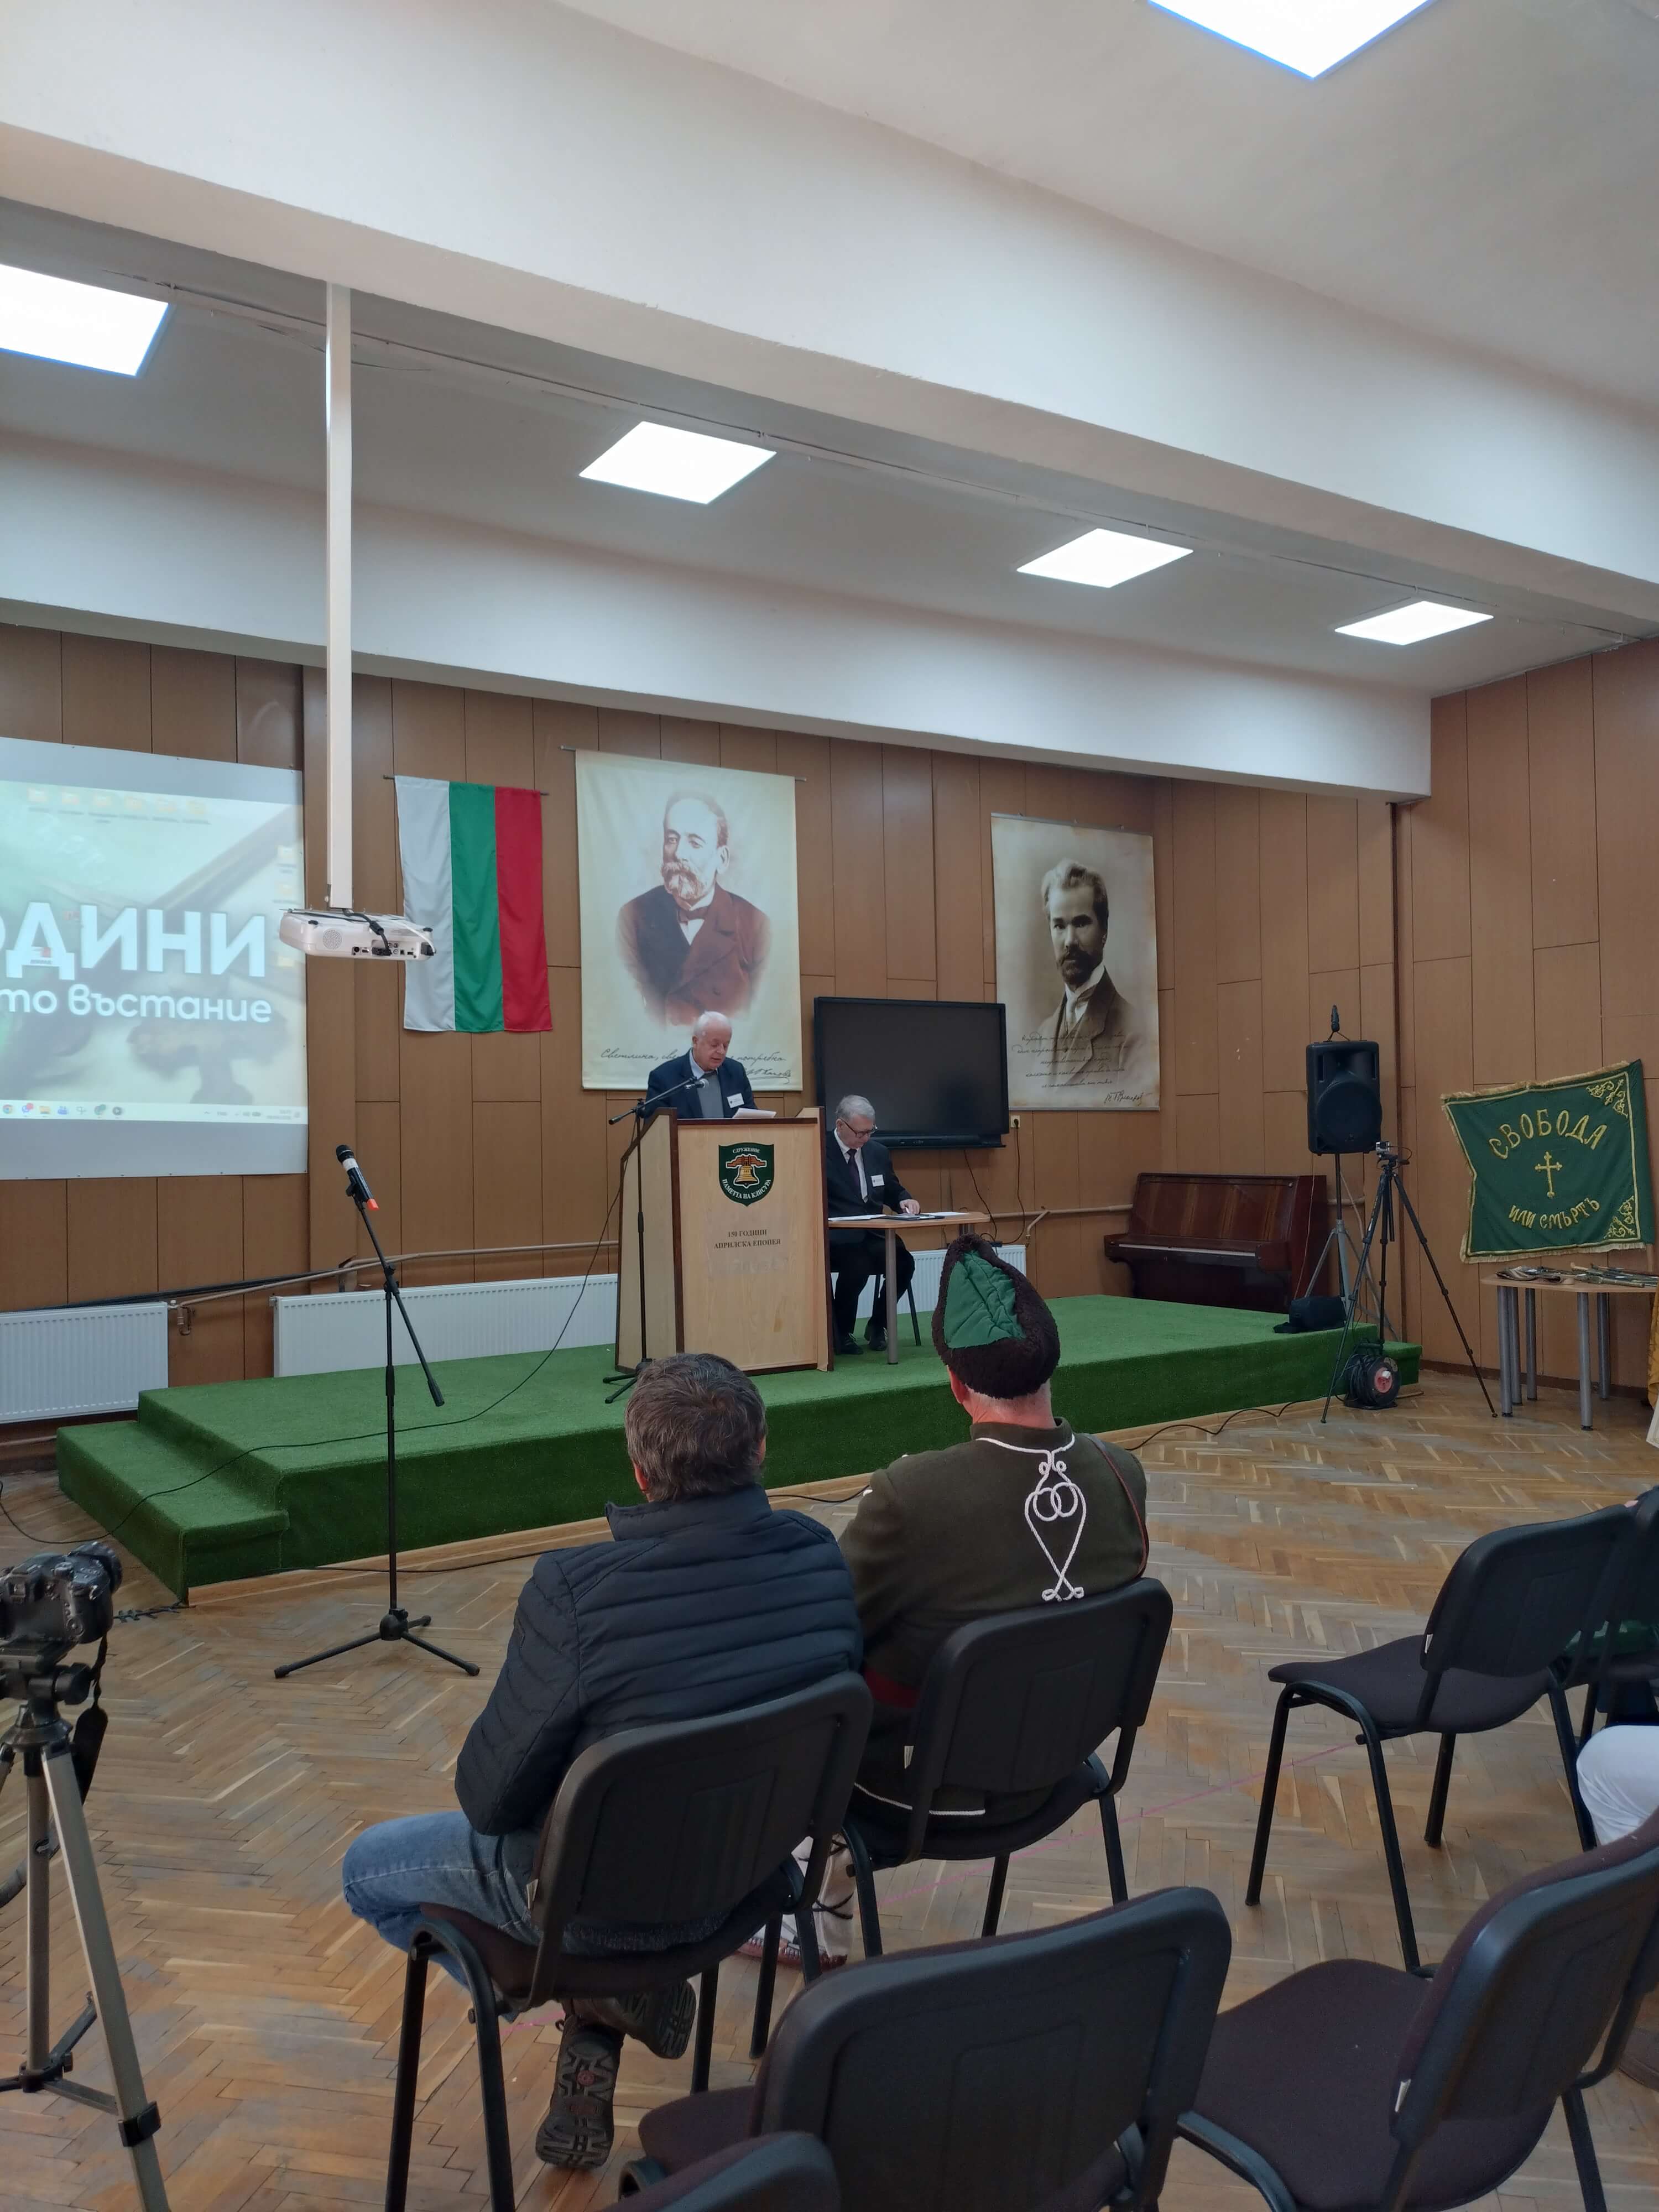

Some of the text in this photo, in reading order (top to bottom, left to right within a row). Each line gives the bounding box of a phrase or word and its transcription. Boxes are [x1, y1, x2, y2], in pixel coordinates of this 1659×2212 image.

[68, 984, 272, 1022] въстание
[1489, 1109, 1607, 1160] СВОБОДА
[714, 1238, 781, 1249] АПРИЛСКА ЕПОПЕЯ
